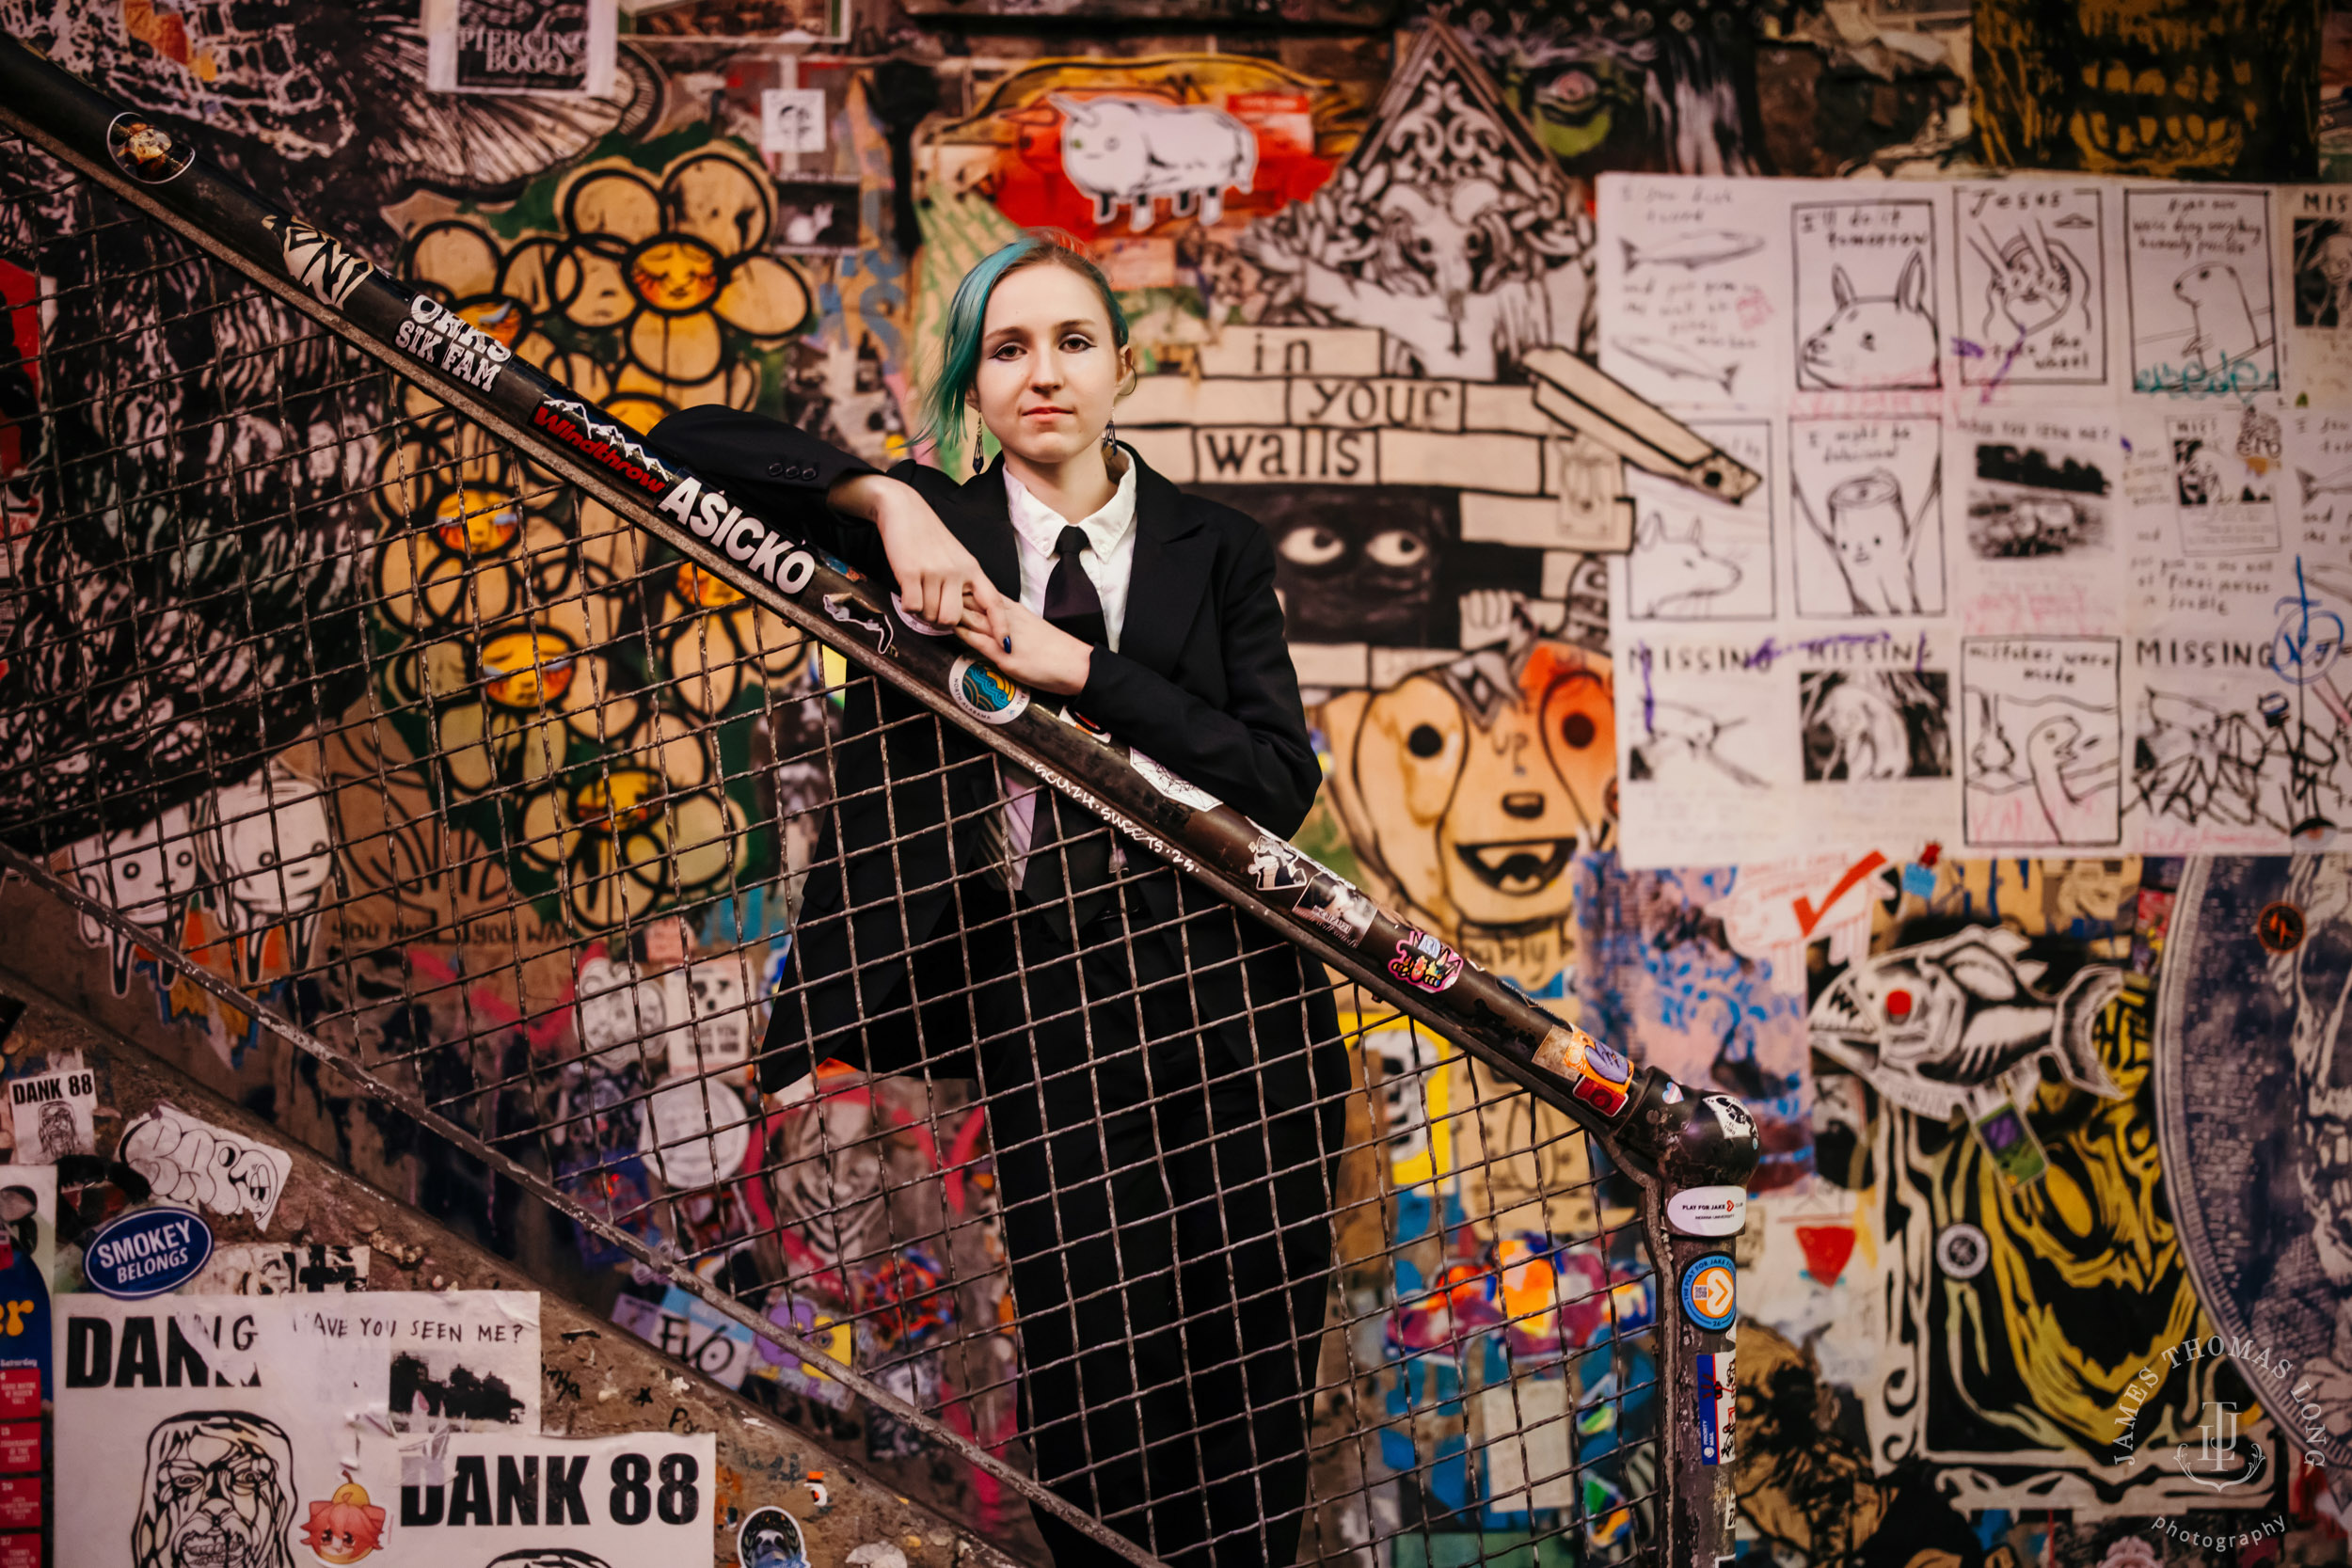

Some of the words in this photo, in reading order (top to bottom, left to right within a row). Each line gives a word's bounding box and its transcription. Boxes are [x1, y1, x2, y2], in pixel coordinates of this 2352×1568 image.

[459, 28, 587, 55] PIERCING
[395, 320, 443, 363] SIK
[441, 342, 501, 392] FAM
[1254, 333, 1311, 372] in
[1308, 380, 1451, 427] your
[533, 405, 666, 493] Windthrow
[1205, 426, 1360, 477] walls
[1629, 646, 1772, 672] MISSING
[2137, 638, 2274, 668] MISSING
[961, 702, 992, 720] ALABAMA
[12, 1077, 62, 1105] DANK
[69, 1073, 93, 1098] 88
[97, 1219, 191, 1269] SMOKEY
[117, 1246, 188, 1285] BELONGS
[1695, 1259, 1708, 1272] FOR
[410, 1320, 463, 1343] SEEN
[478, 1323, 523, 1343] ME?
[401, 1456, 591, 1527] DANK
[610, 1453, 699, 1526] 88
